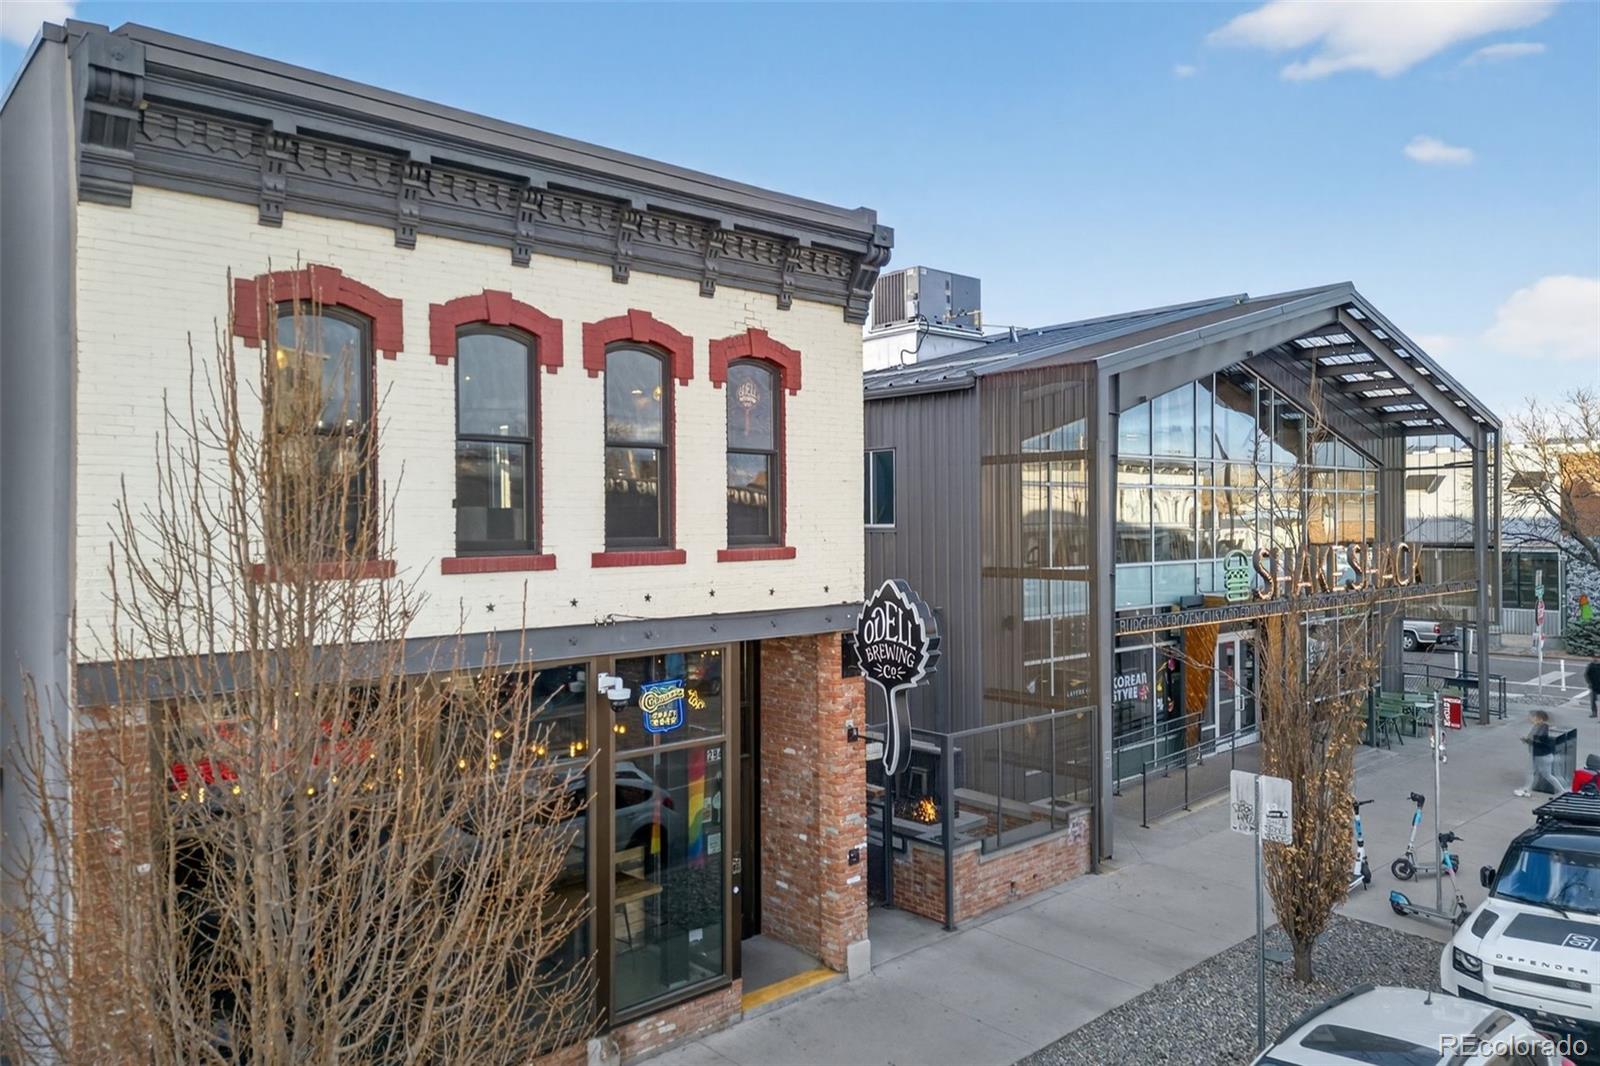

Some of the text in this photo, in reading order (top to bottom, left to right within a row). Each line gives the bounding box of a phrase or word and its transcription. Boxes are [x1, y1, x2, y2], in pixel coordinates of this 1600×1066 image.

[1252, 542, 1423, 600] SHAKE SHACK
[864, 601, 916, 651] ODELL
[865, 643, 916, 668] BREWING
[1495, 953, 1588, 975] DEFENDER
